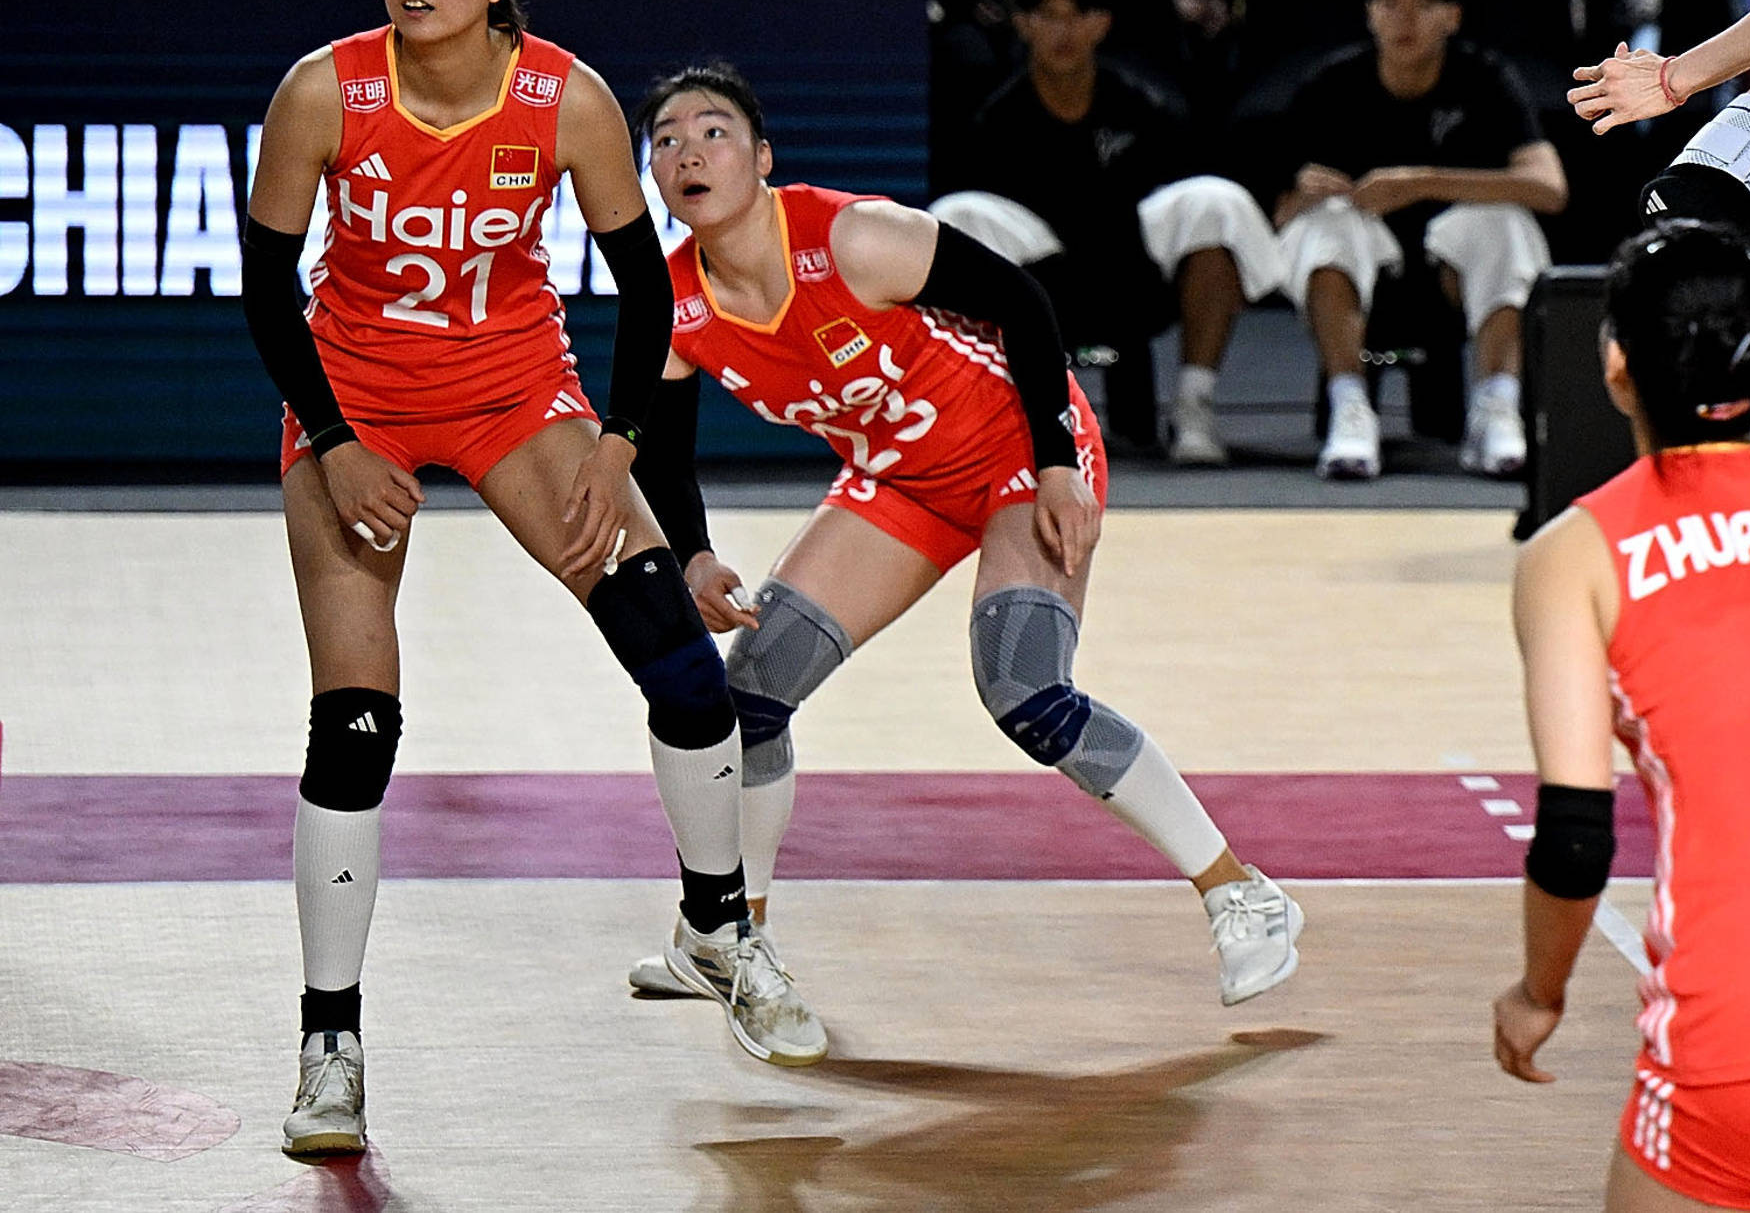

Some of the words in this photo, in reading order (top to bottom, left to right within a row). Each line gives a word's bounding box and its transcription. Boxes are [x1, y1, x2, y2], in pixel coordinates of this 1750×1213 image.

[346, 80, 387, 103] 光明
[516, 72, 559, 99] 光明
[496, 175, 531, 186] CHN
[382, 251, 496, 328] 21
[834, 337, 867, 364] CHN
